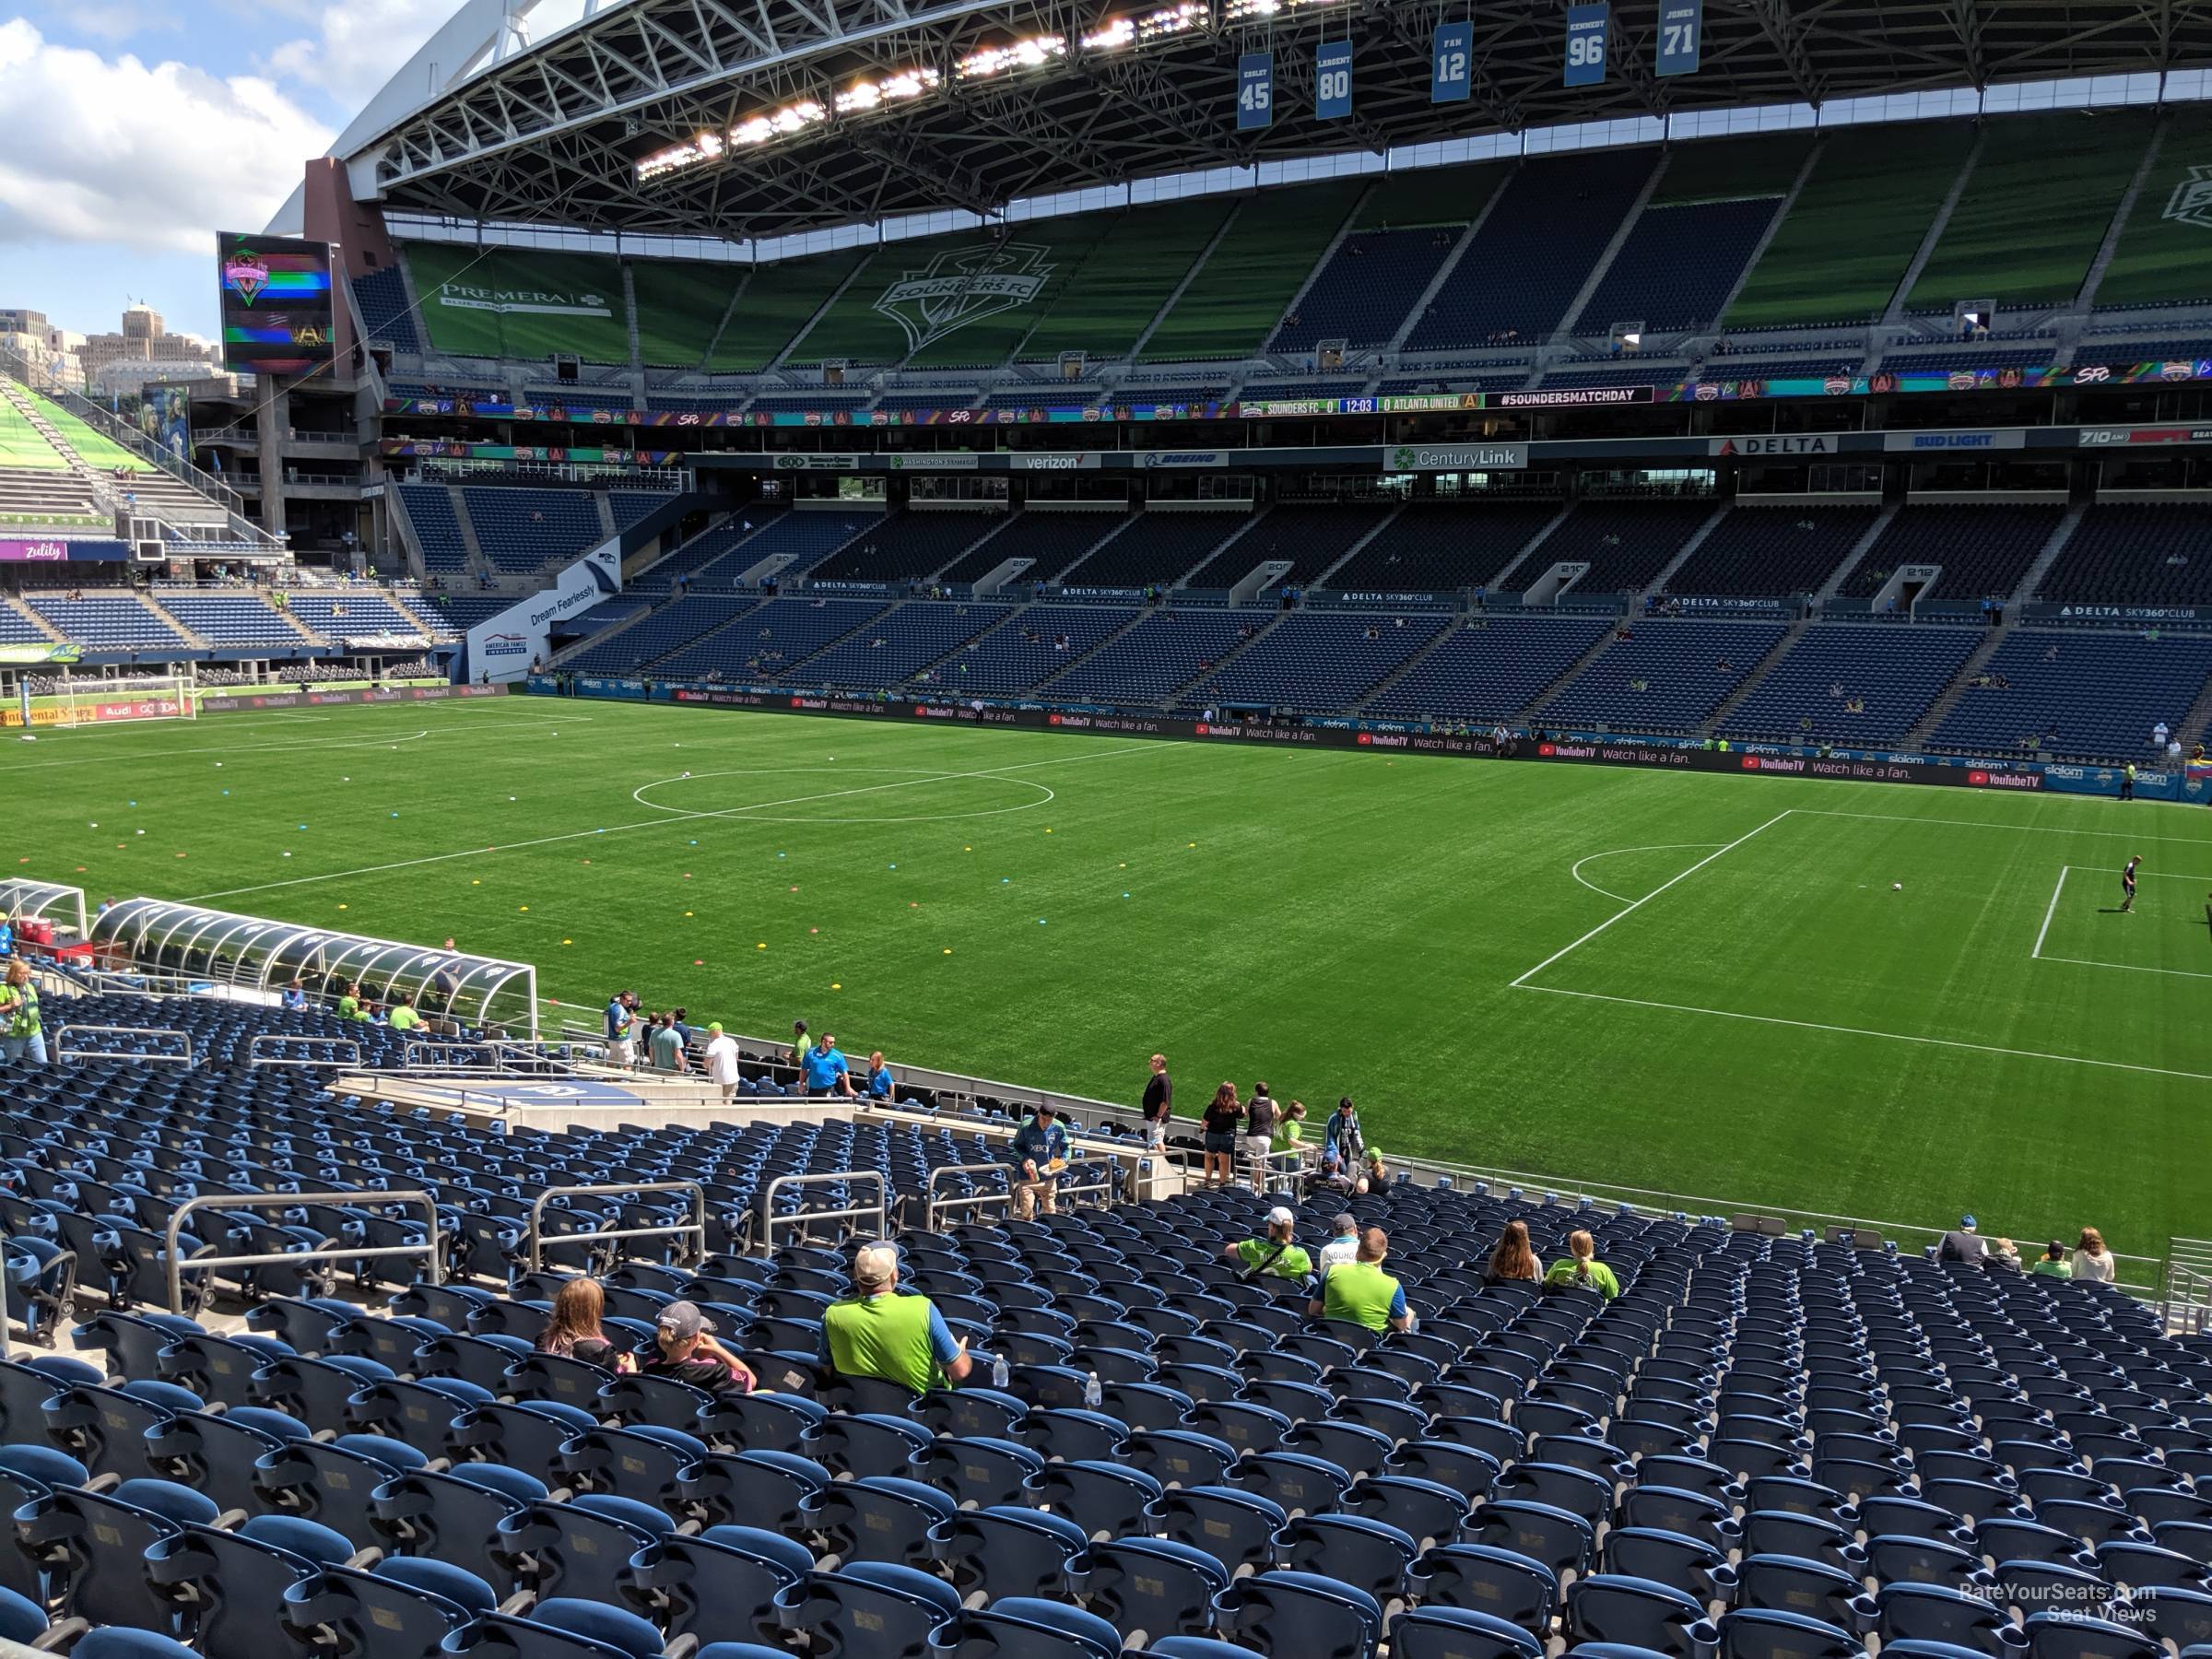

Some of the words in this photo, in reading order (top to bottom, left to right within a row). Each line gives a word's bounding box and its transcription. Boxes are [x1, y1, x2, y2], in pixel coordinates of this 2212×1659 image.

[1666, 8, 1694, 19] JONES
[1443, 38, 1462, 48] FAN
[1664, 24, 1694, 56] 71
[1569, 35, 1604, 66] 96
[1438, 53, 1465, 82] 12
[1319, 70, 1348, 100] 80
[1240, 82, 1269, 111] 45
[442, 284, 567, 304] PREMERA
[1007, 283, 1031, 294] FC
[2074, 367, 2110, 384] SFC
[1393, 398, 1429, 411] ATLANTA
[1430, 397, 1458, 409] UNITED
[1500, 389, 1634, 406] #SOUNDERSMATCHDAY
[1267, 403, 1307, 415] SOUNDERS
[1309, 402, 1319, 413] FC
[1326, 402, 1334, 412] 0
[1346, 398, 1371, 412] 12:03
[1383, 400, 1390, 411] 0
[677, 414, 700, 425] SFC
[949, 411, 971, 422] SFC
[1914, 436, 1946, 447] BUD
[1947, 434, 1993, 446] LIGHT
[2079, 431, 2112, 443] 710
[1747, 438, 1826, 453] DELTA
[1027, 455, 1077, 468] verizon
[1161, 453, 1217, 463] BOEING
[1419, 450, 1515, 467] CenturyLink
[1352, 593, 1382, 601] DELTA
[1682, 598, 1719, 606] DELTA
[531, 606, 557, 626] Dream
[557, 585, 594, 612] Fearlessly
[2076, 606, 2120, 616] DELTA
[0, 709, 59, 724] ontiental
[106, 705, 132, 716] Audi
[958, 710, 977, 718] Watc
[983, 712, 994, 720] ike
[1095, 719, 1120, 728] Watch
[1122, 720, 1135, 730] like
[1143, 722, 1158, 731] fan.
[1246, 728, 1273, 738] Watch
[1275, 729, 1289, 739] like
[1299, 730, 1316, 741] fan.
[1414, 738, 1444, 749] Watch
[1447, 739, 1463, 750] like
[1474, 740, 1493, 752] fan.
[1603, 748, 1636, 760] Watch
[1639, 750, 1657, 762] like
[1660, 754, 1667, 762] a
[1670, 751, 1690, 764] fan.
[1888, 754, 1924, 765] slalom
[1813, 762, 1851, 775] Watch
[1853, 764, 1873, 776] like
[1877, 768, 1885, 776] a
[1888, 766, 1911, 779] fan.
[1965, 759, 2002, 770] slalom
[2045, 765, 2084, 776] slalom
[1328, 1252, 1357, 1260] NOUHO
